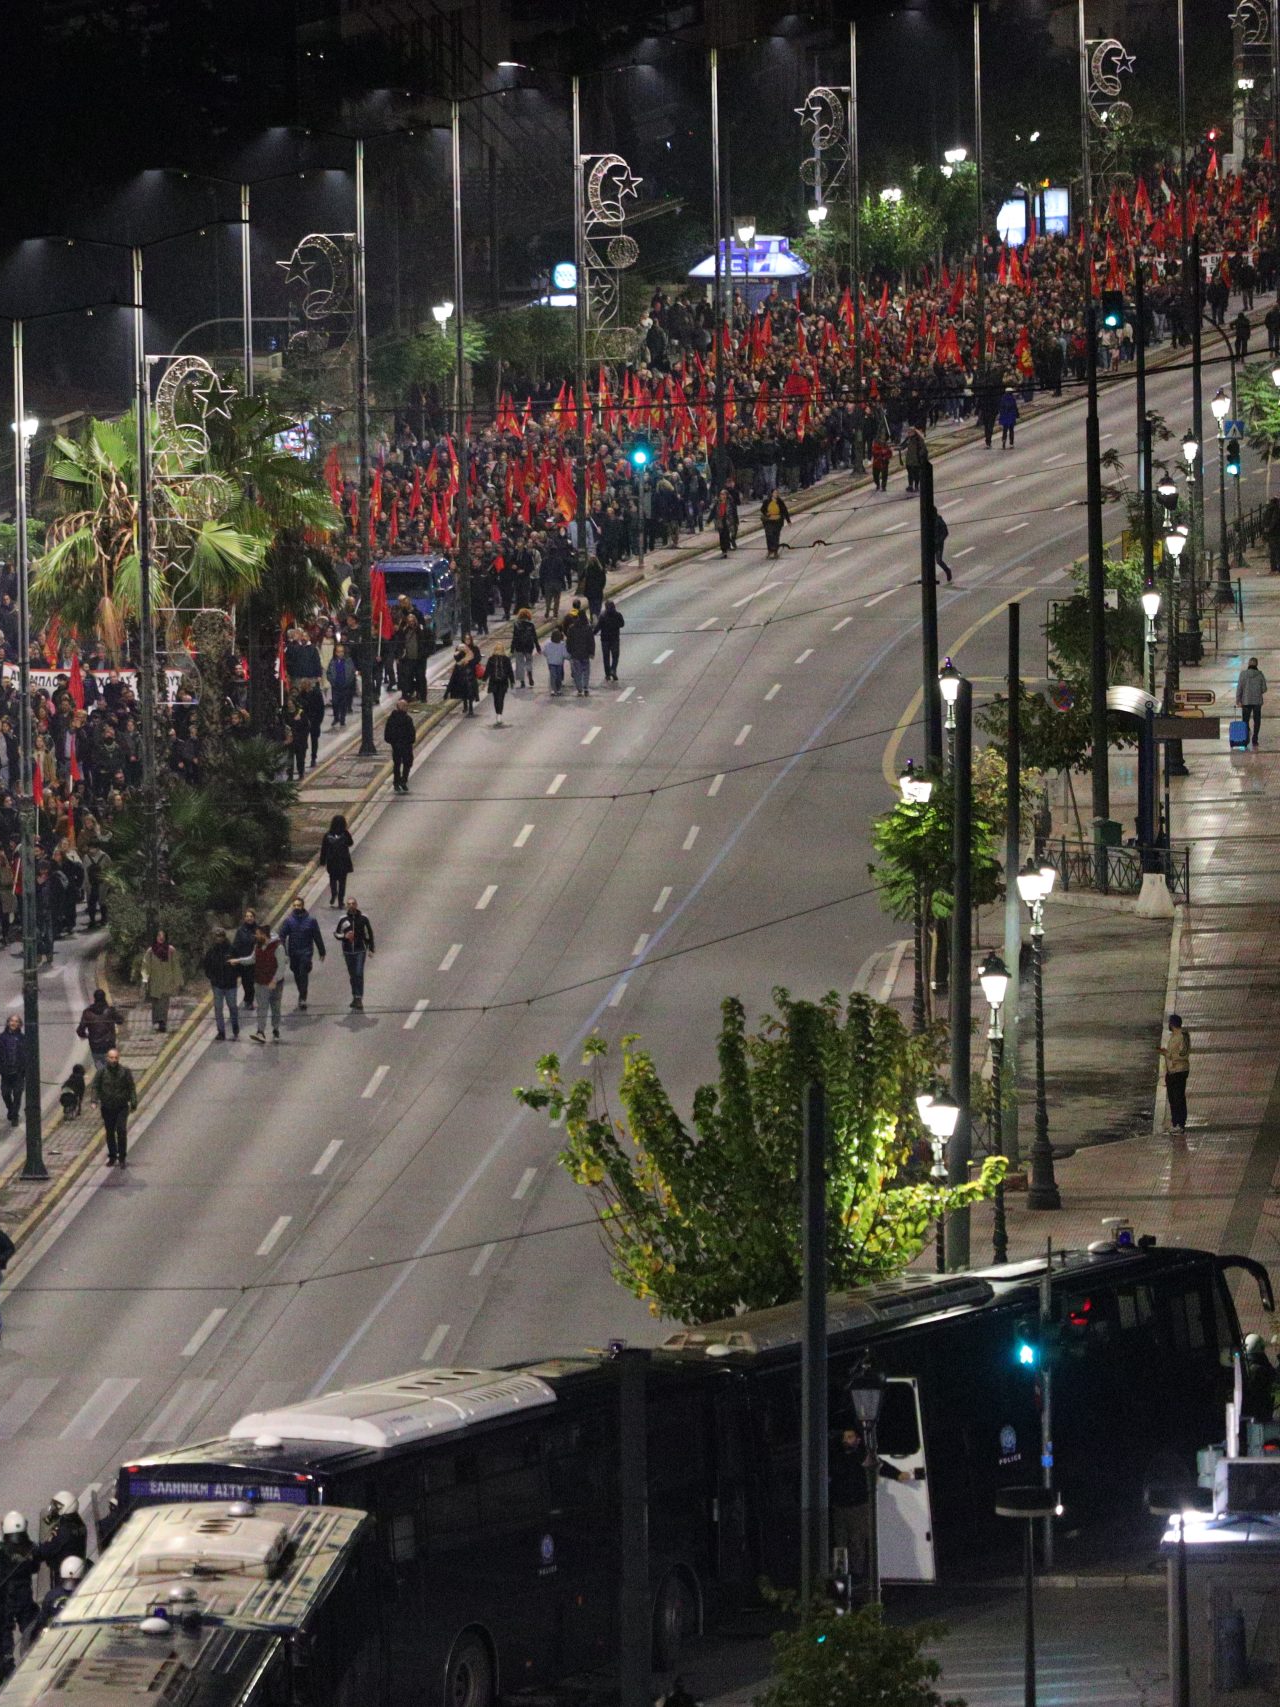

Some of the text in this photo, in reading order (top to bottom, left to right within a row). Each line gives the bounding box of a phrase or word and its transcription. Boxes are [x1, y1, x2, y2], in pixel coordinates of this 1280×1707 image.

[998, 1453, 1021, 1466] POLICE
[149, 1480, 281, 1500] ΕΛΛΗΝΙΚΗ ΑΣΤΥΜΙΑ
